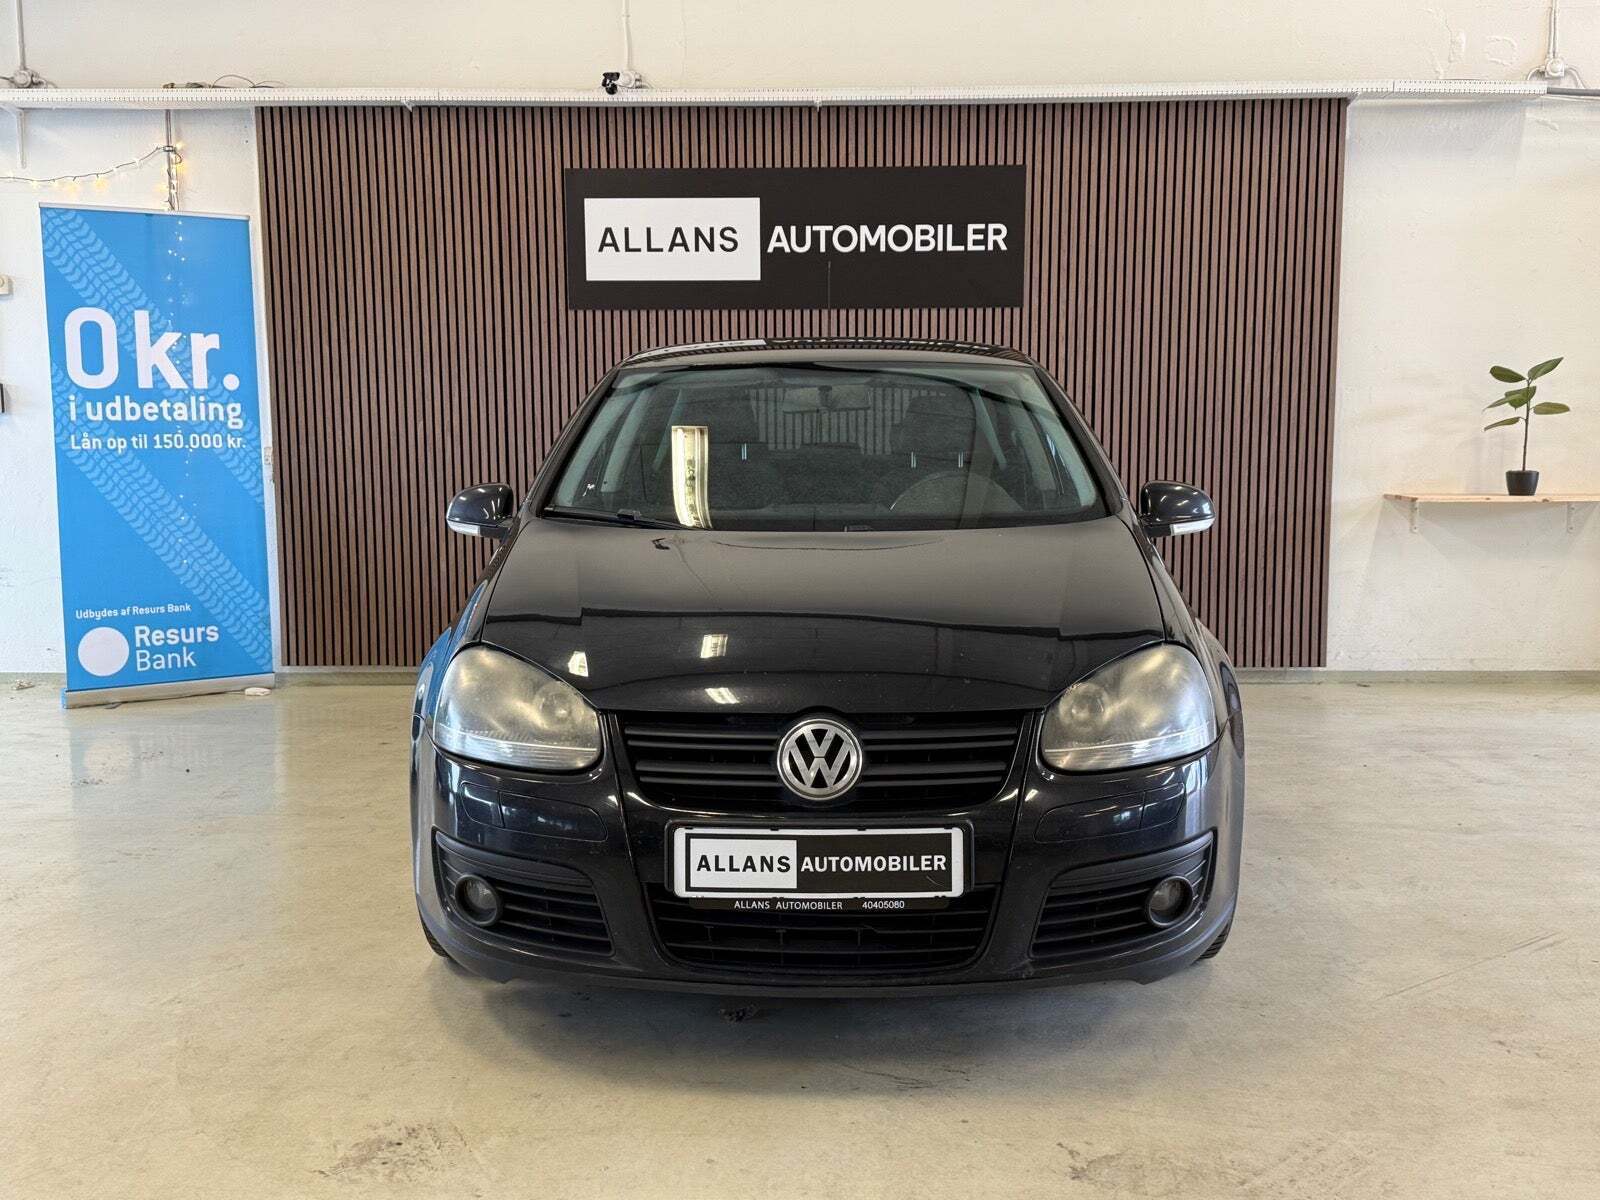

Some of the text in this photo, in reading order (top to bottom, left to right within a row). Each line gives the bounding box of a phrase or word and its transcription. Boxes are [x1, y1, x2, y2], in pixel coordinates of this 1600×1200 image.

[598, 223, 1009, 254] ALLANS AUTOMOBILER
[64, 307, 240, 391] 0 kr.
[69, 394, 242, 430] i udbetaling
[71, 432, 246, 453] Lån op til 150.000 kr.
[75, 603, 192, 621] Udbydes af Resurs Bank
[134, 624, 219, 647] Resurs
[136, 647, 197, 672] Bank
[696, 854, 947, 873] ALLANS AUTOMOBILER
[734, 900, 770, 910] ALLANS
[776, 901, 843, 911] AUTOMOBILER
